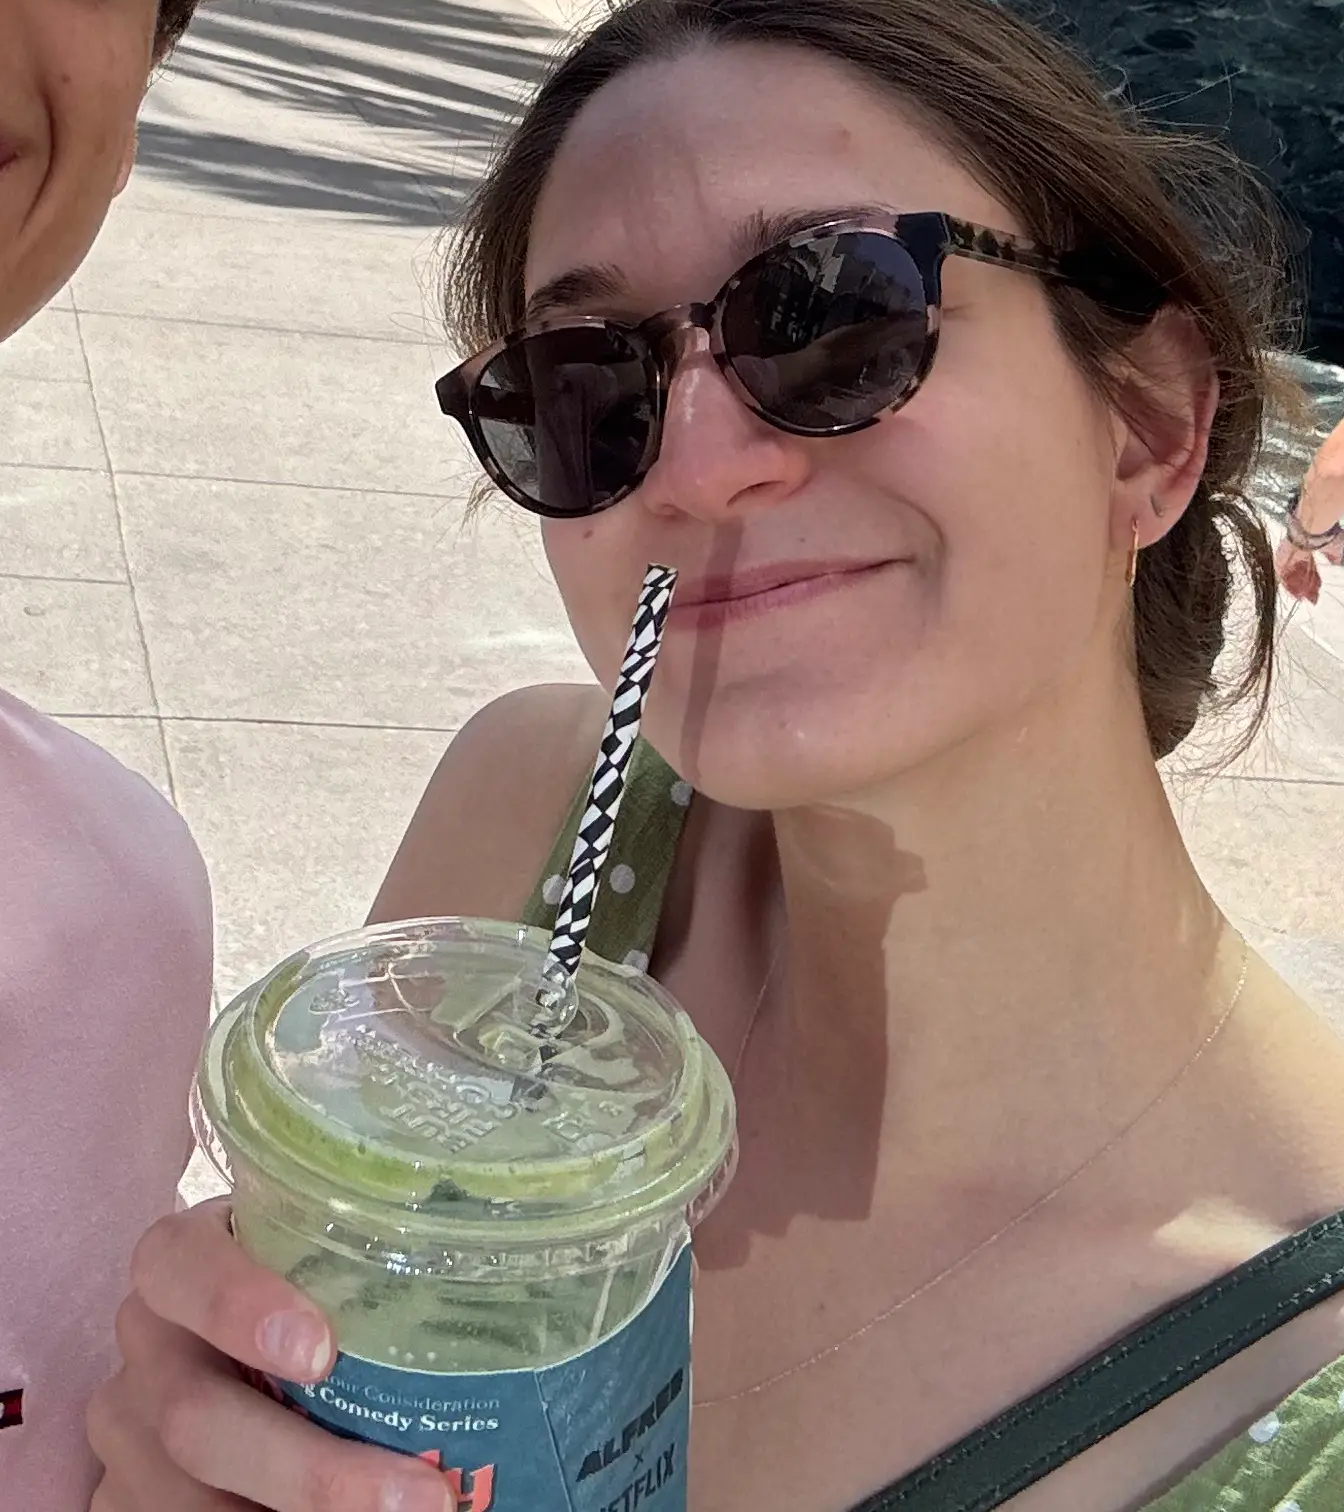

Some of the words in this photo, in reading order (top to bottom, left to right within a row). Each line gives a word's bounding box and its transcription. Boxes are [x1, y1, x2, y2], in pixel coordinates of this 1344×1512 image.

[319, 1386, 413, 1433] Comedy
[418, 1414, 501, 1433] Series
[364, 1384, 500, 1413] Consideration
